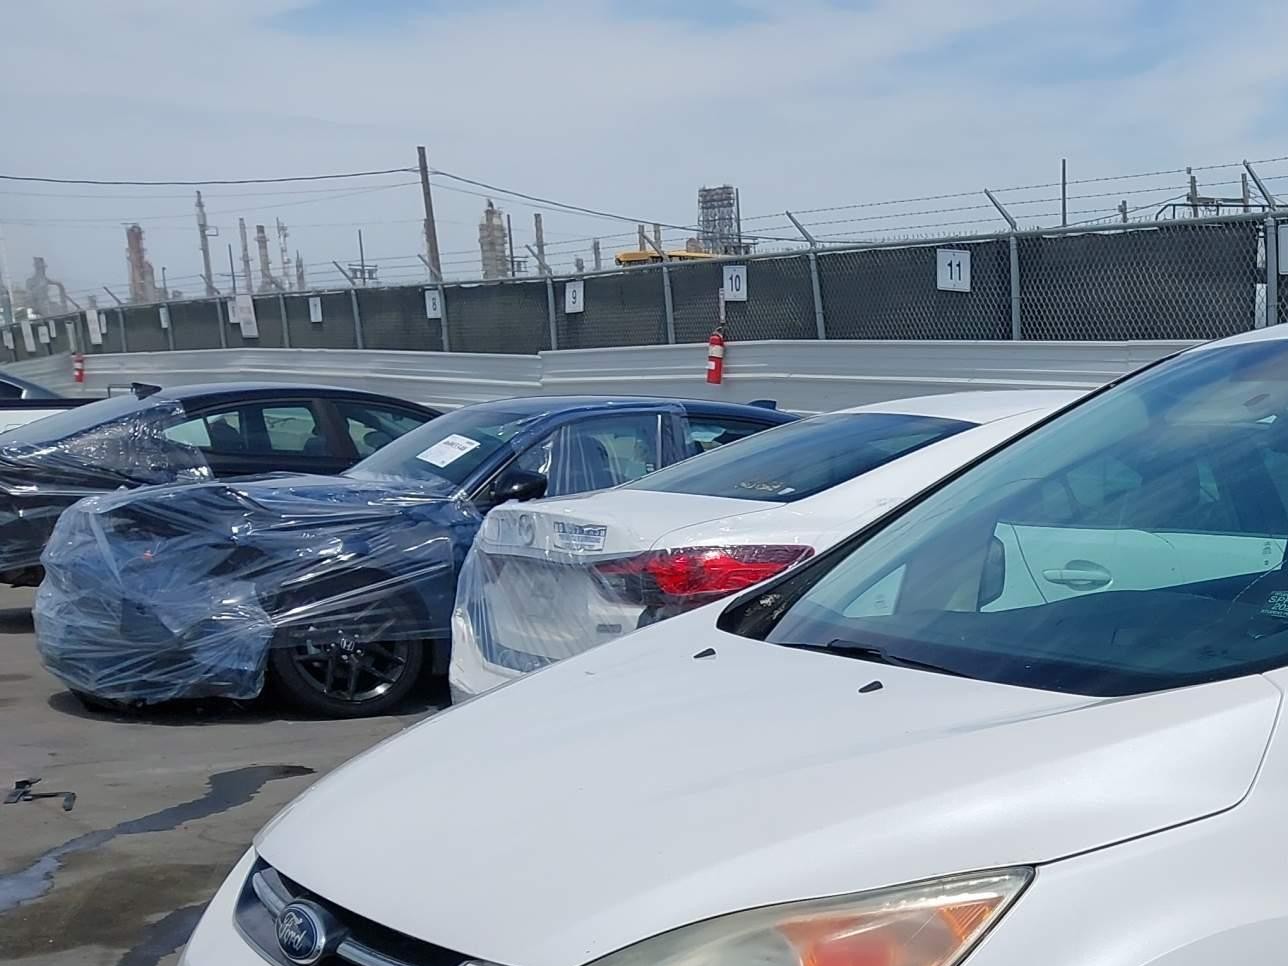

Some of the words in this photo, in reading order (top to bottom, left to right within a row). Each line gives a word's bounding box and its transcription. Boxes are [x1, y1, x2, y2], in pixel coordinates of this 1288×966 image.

[947, 259, 962, 281] 11
[729, 274, 741, 292] 10
[571, 289, 577, 305] 9
[279, 911, 307, 951] Ford
